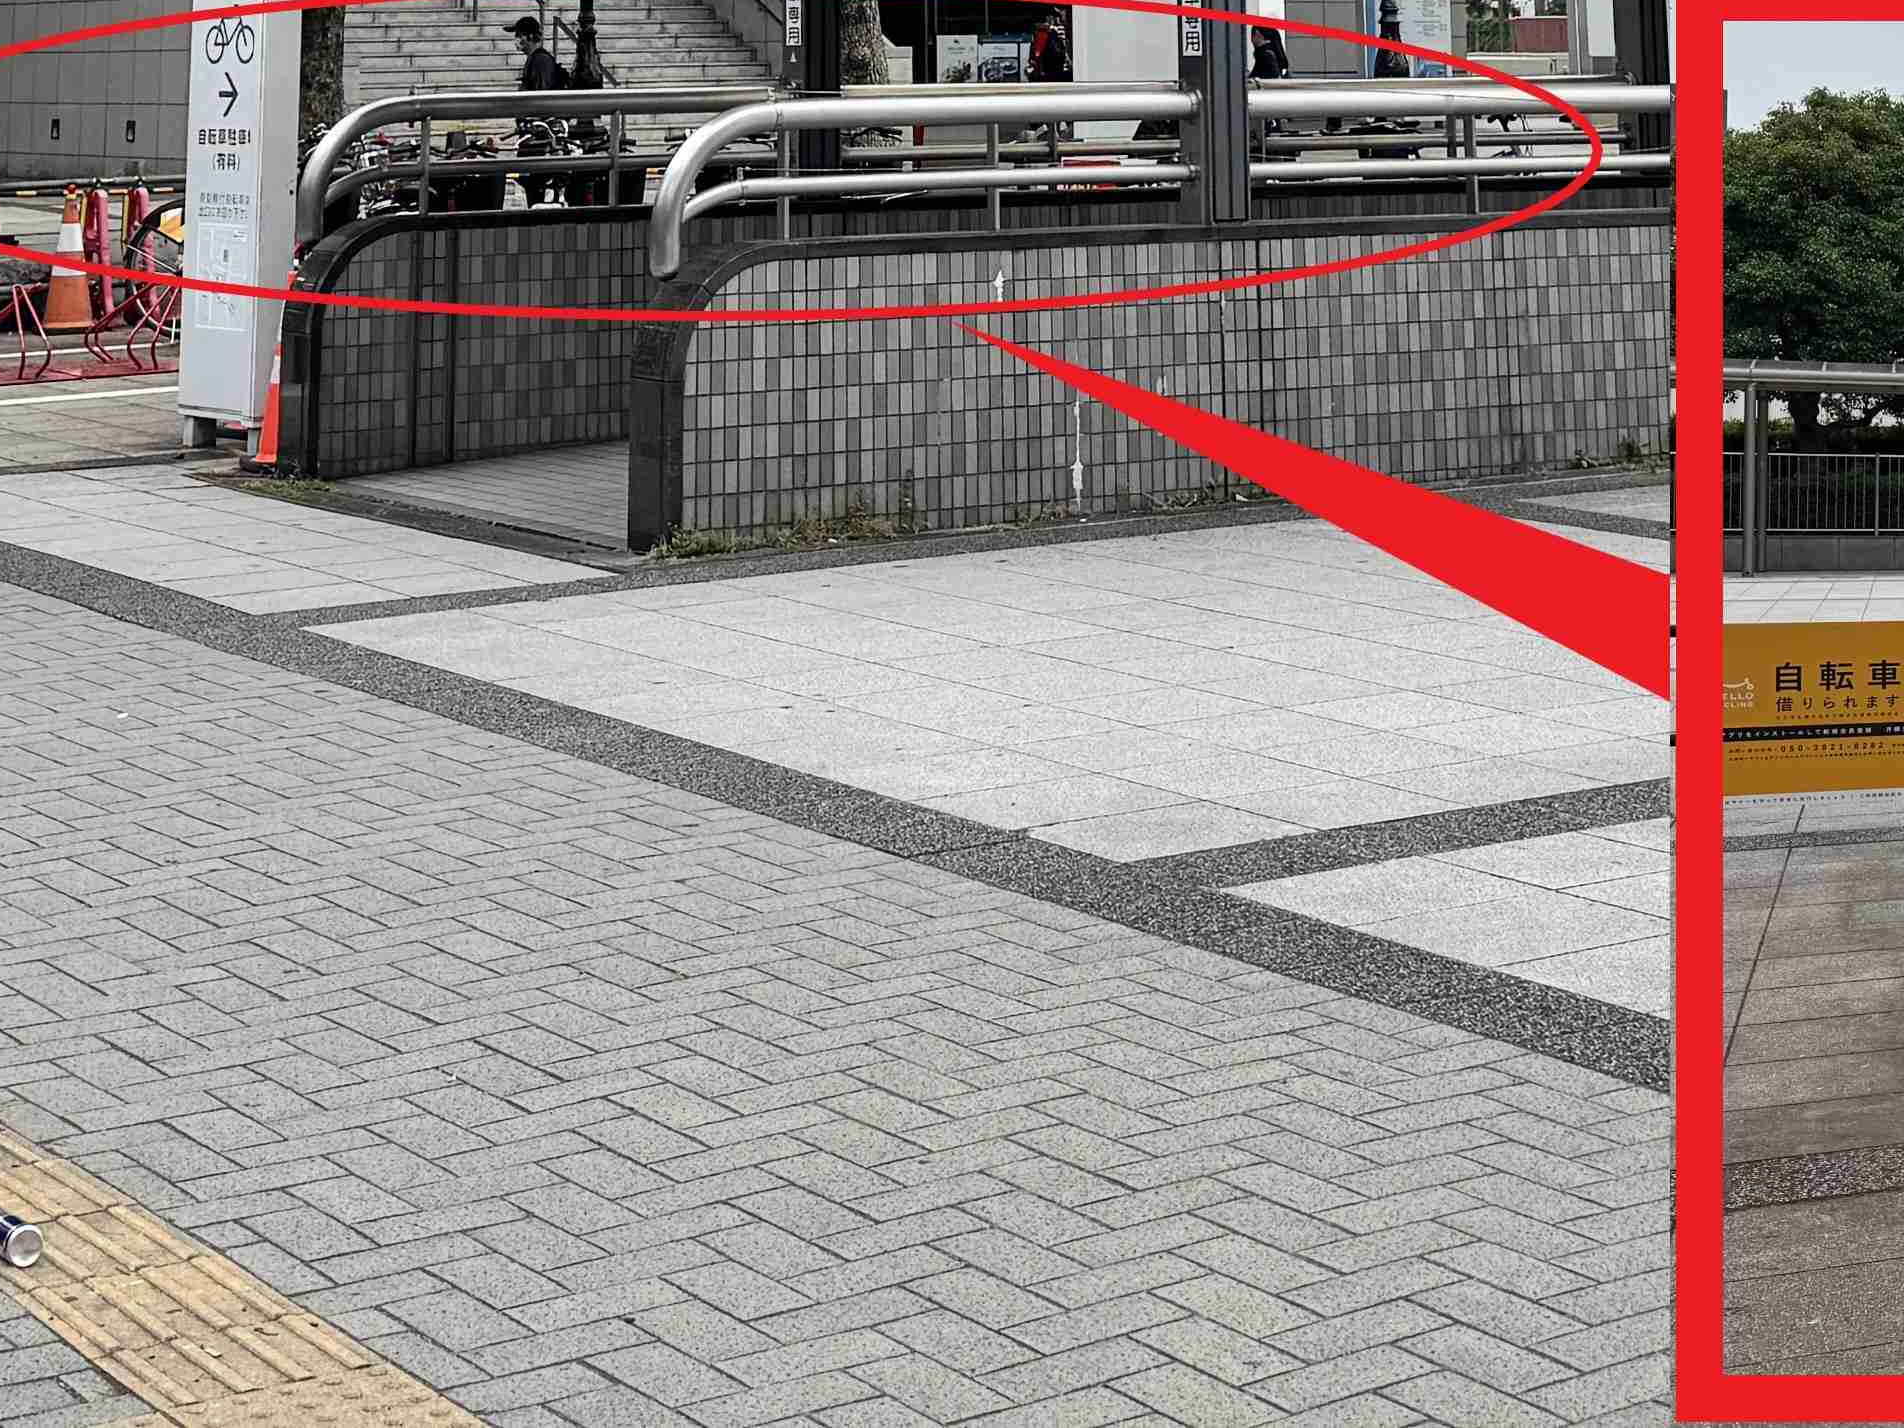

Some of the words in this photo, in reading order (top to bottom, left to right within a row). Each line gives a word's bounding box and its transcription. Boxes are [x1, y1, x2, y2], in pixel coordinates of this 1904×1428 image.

[1775, 659, 1902, 693] 自転車
[1775, 695, 1900, 712] 借りられます
